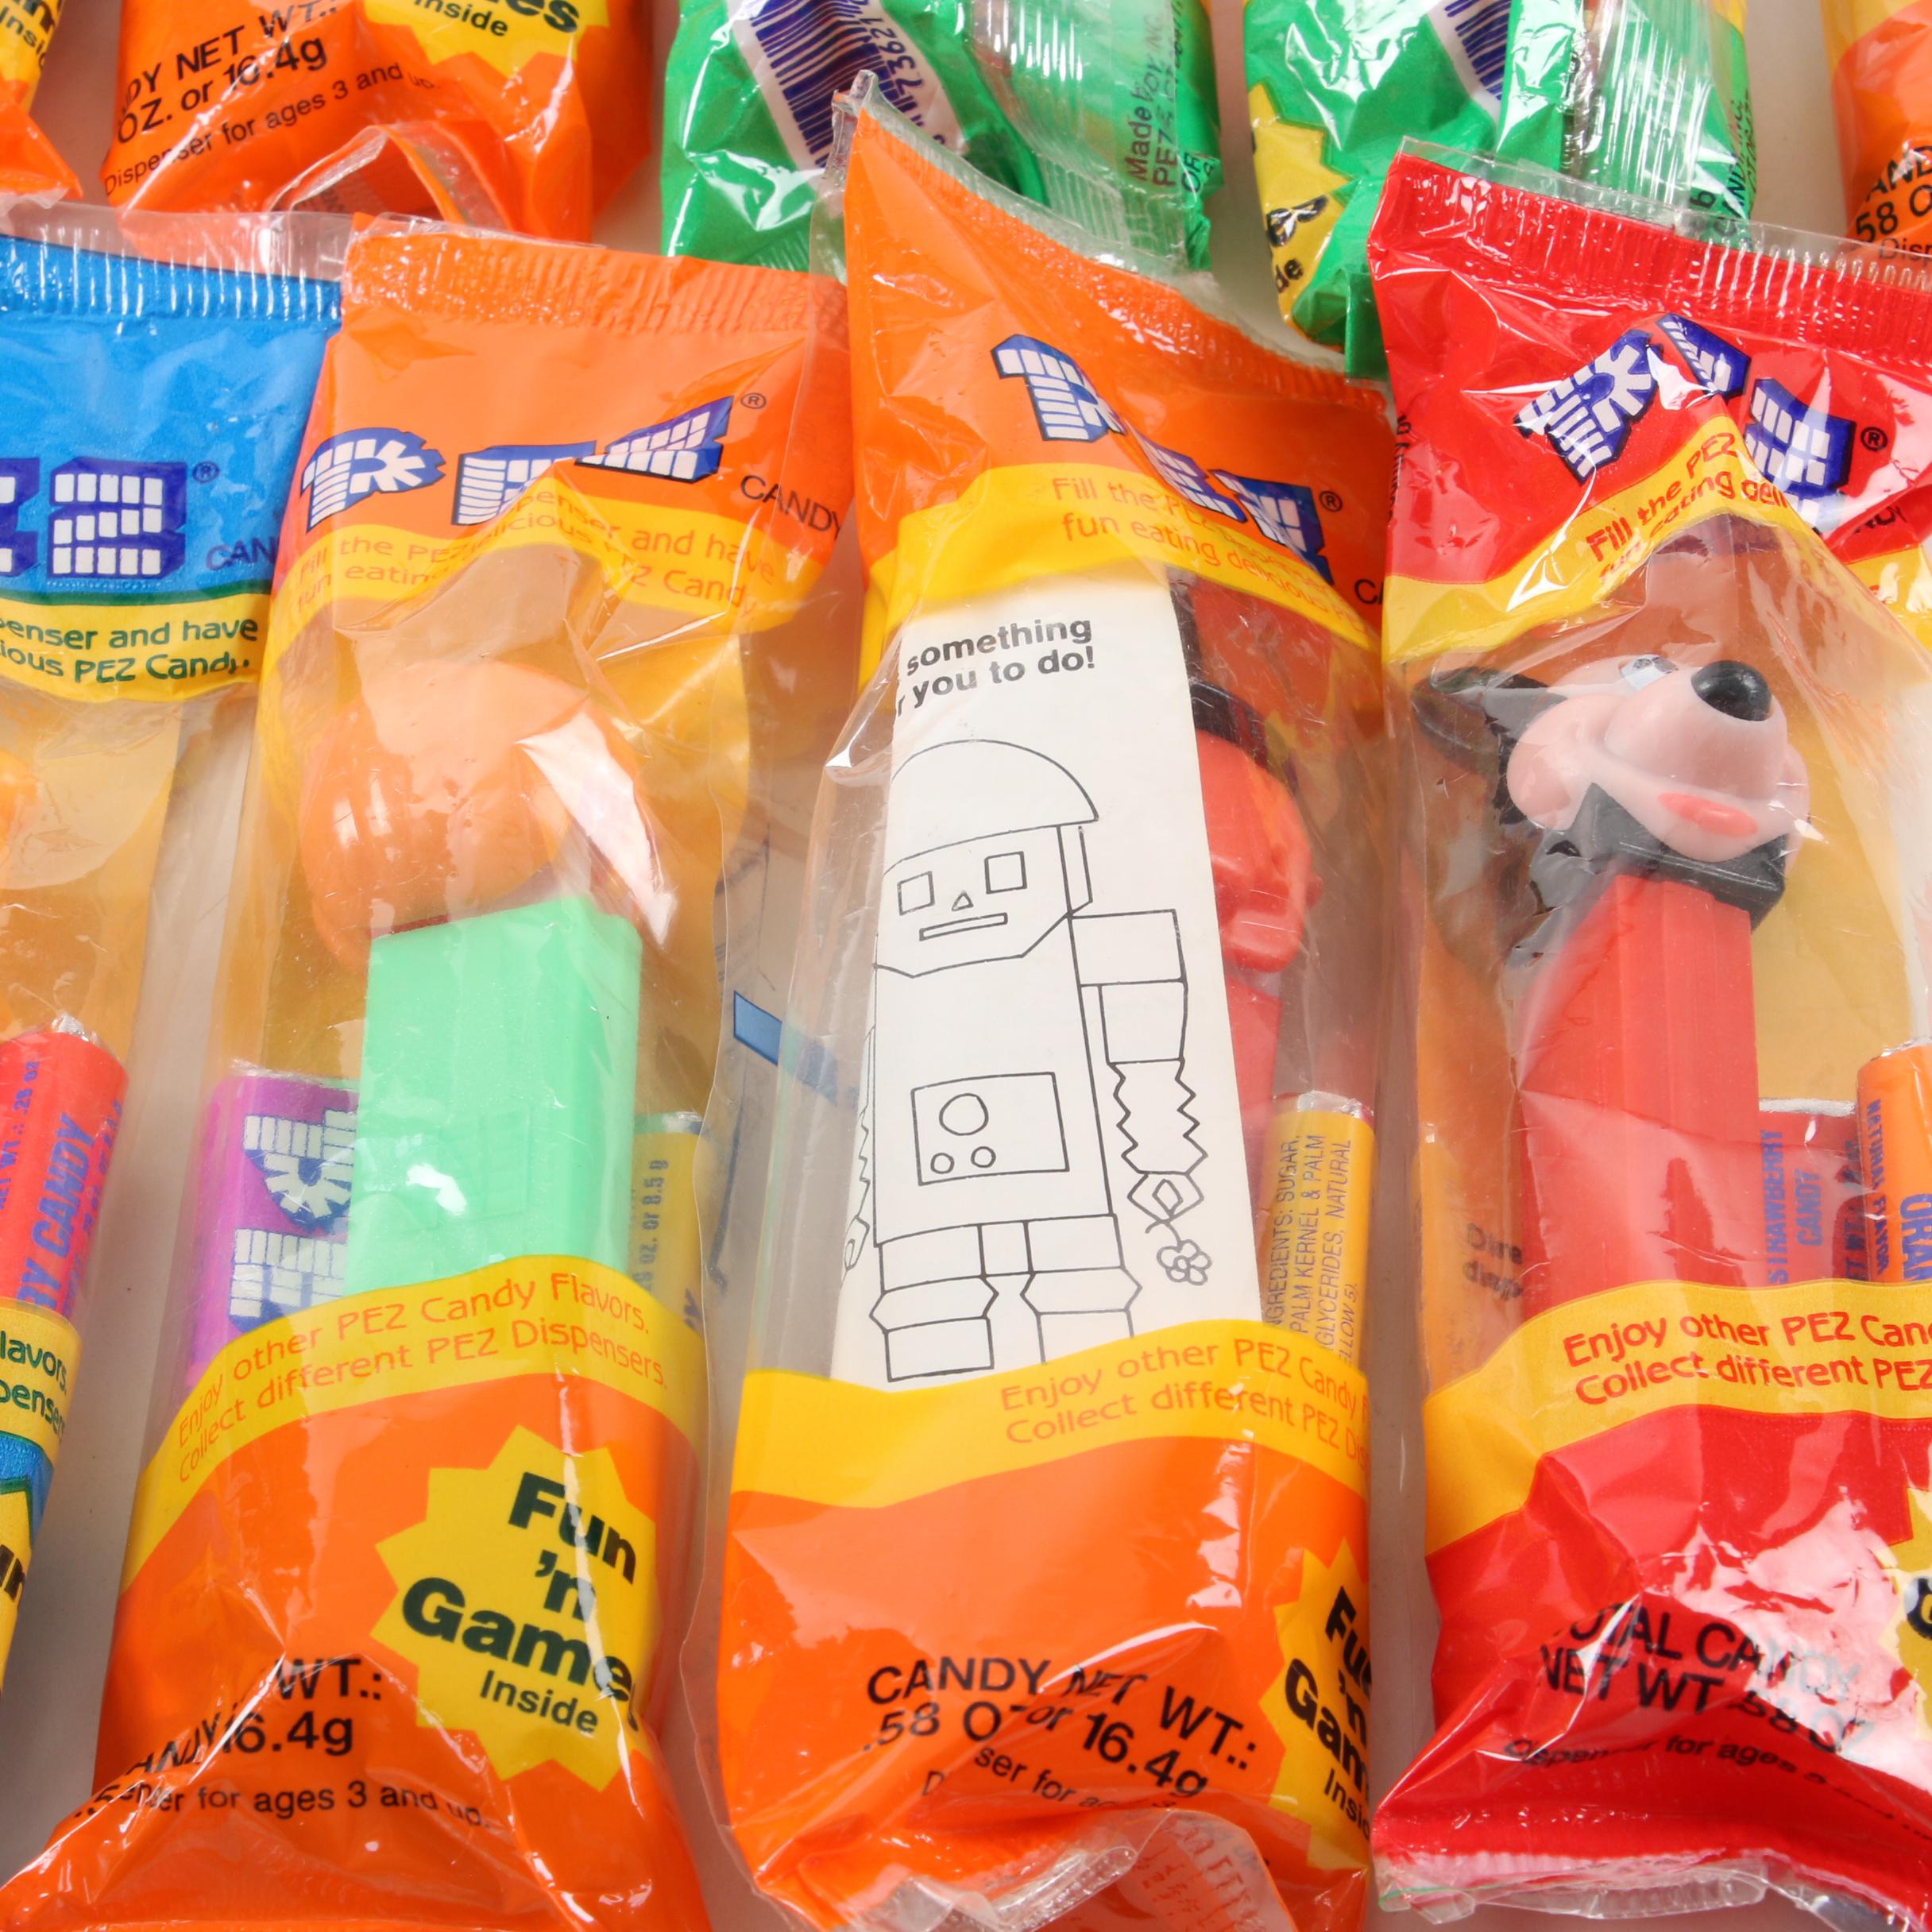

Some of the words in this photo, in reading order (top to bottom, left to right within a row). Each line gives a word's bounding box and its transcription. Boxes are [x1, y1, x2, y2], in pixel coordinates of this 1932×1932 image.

[176, 25, 245, 80] NET
[118, 98, 172, 144] OZ.
[180, 80, 213, 112] or
[222, 37, 327, 91] 16.4g
[103, 131, 213, 197] Dispenser
[221, 119, 256, 145] for
[265, 92, 326, 130] ages
[332, 80, 349, 101] 3
[357, 62, 404, 91] and
[1122, 105, 1153, 183] Made
[740, 474, 840, 541] CANDY
[1052, 477, 1099, 501] Fill
[1107, 481, 1159, 512] the
[1585, 516, 1634, 562] Fill
[1636, 480, 1683, 527] the
[1686, 431, 1739, 480] PEZ
[340, 535, 394, 557] the
[631, 530, 696, 557] and
[1063, 511, 1121, 542] fun
[1130, 520, 1222, 568] eating
[109, 621, 171, 649] and
[182, 618, 259, 642] have
[906, 618, 1092, 676] something
[75, 657, 136, 684] PEZ
[912, 669, 978, 709] you
[989, 660, 1026, 685] to
[1037, 644, 1095, 674] do!
[31, 1112, 95, 1259] CANDY
[1302, 1134, 1326, 1183] PALM
[1325, 1138, 1351, 1219] NATURAL
[1300, 1184, 1321, 1202] &
[1795, 1169, 1823, 1246] CANDY
[1294, 1208, 1320, 1278] KERNEL
[1289, 1284, 1312, 1334] PALM
[1563, 1316, 1667, 1369] Enjoy
[1679, 1315, 1770, 1347] other
[1780, 1311, 1856, 1347] PEZ
[1861, 1314, 1932, 1348] Can
[179, 1374, 224, 1434] Enjoy
[233, 1327, 323, 1381] other
[338, 1304, 408, 1342] PEZ
[420, 1277, 537, 1323] Candy
[550, 1273, 650, 1335] Flavors.
[1000, 1369, 1103, 1412] Enjoy
[1116, 1342, 1219, 1378] other
[1233, 1338, 1292, 1379] PEZ
[1299, 1356, 1357, 1420] Candy
[1575, 1350, 1708, 1405] Collect
[1716, 1354, 1869, 1388] different
[179, 1398, 247, 1484] Collect
[257, 1343, 414, 1410] different
[427, 1327, 500, 1365] PEZ
[511, 1316, 669, 1391] Dispensers.
[1005, 1392, 1138, 1445] Collect
[1150, 1379, 1296, 1428] different
[1302, 1401, 1341, 1450] PEZ
[508, 1470, 637, 1586] Fun
[276, 1656, 382, 1702] WT.:
[479, 1669, 600, 1734] Inside
[867, 1656, 1052, 1706] CANDY
[1159, 1685, 1257, 1771] WT.:
[864, 1701, 940, 1752] .58
[1083, 1711, 1208, 1799] 16.4g
[198, 1785, 239, 1810] for
[253, 1788, 335, 1820] ages
[347, 1779, 368, 1809] 3
[380, 1785, 439, 1810] and
[1032, 1768, 1076, 1802] for
